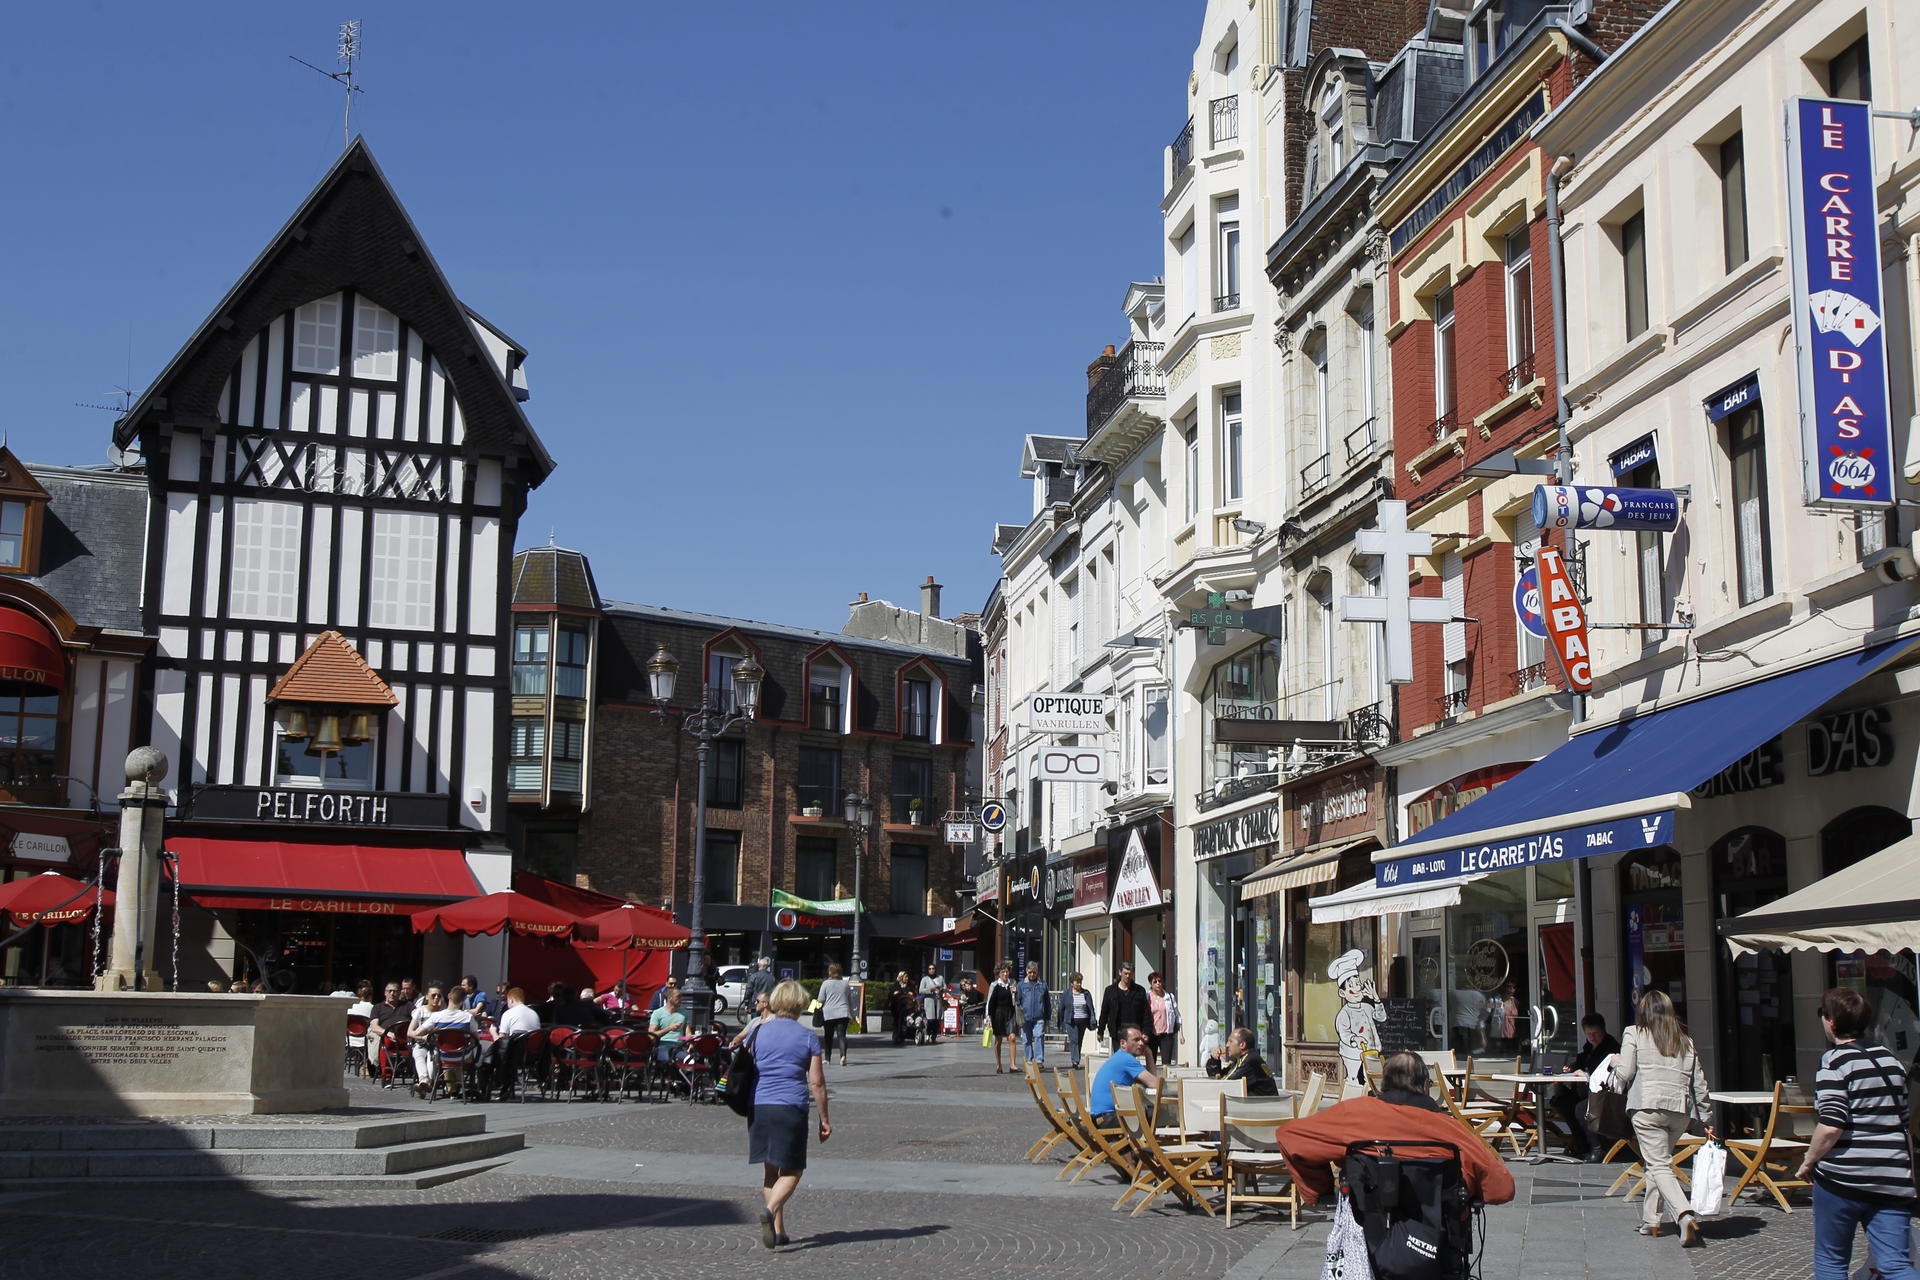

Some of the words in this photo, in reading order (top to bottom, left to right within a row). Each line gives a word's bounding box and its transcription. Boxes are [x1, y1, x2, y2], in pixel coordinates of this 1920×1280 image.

[1820, 106, 1844, 150] LE
[1818, 171, 1855, 282] CARRE
[1722, 385, 1748, 412] BAR
[1620, 441, 1651, 470] TABAC
[1832, 460, 1873, 482] 1664
[1627, 511, 1645, 519] DES
[1648, 512, 1672, 521] JEUX
[1541, 550, 1592, 686] TABAC
[1033, 697, 1103, 716] OPTIQUE
[1037, 719, 1100, 729] VANRULLEN
[256, 791, 388, 823] PELFORTH
[13, 840, 24, 849] LE
[26, 841, 67, 853] CARILLON
[1412, 862, 1426, 876] BAR
[1429, 860, 1446, 873] LOTO
[1461, 850, 1477, 873] LE
[1478, 844, 1525, 869] CARRE
[1528, 835, 1564, 862] D'AS
[1586, 830, 1614, 847] TABAC
[270, 899, 293, 910] LE
[300, 900, 395, 914] CARILLON
[515, 921, 526, 930] LE
[636, 938, 647, 947] LE
[1407, 1234, 1438, 1254] MEYRA
